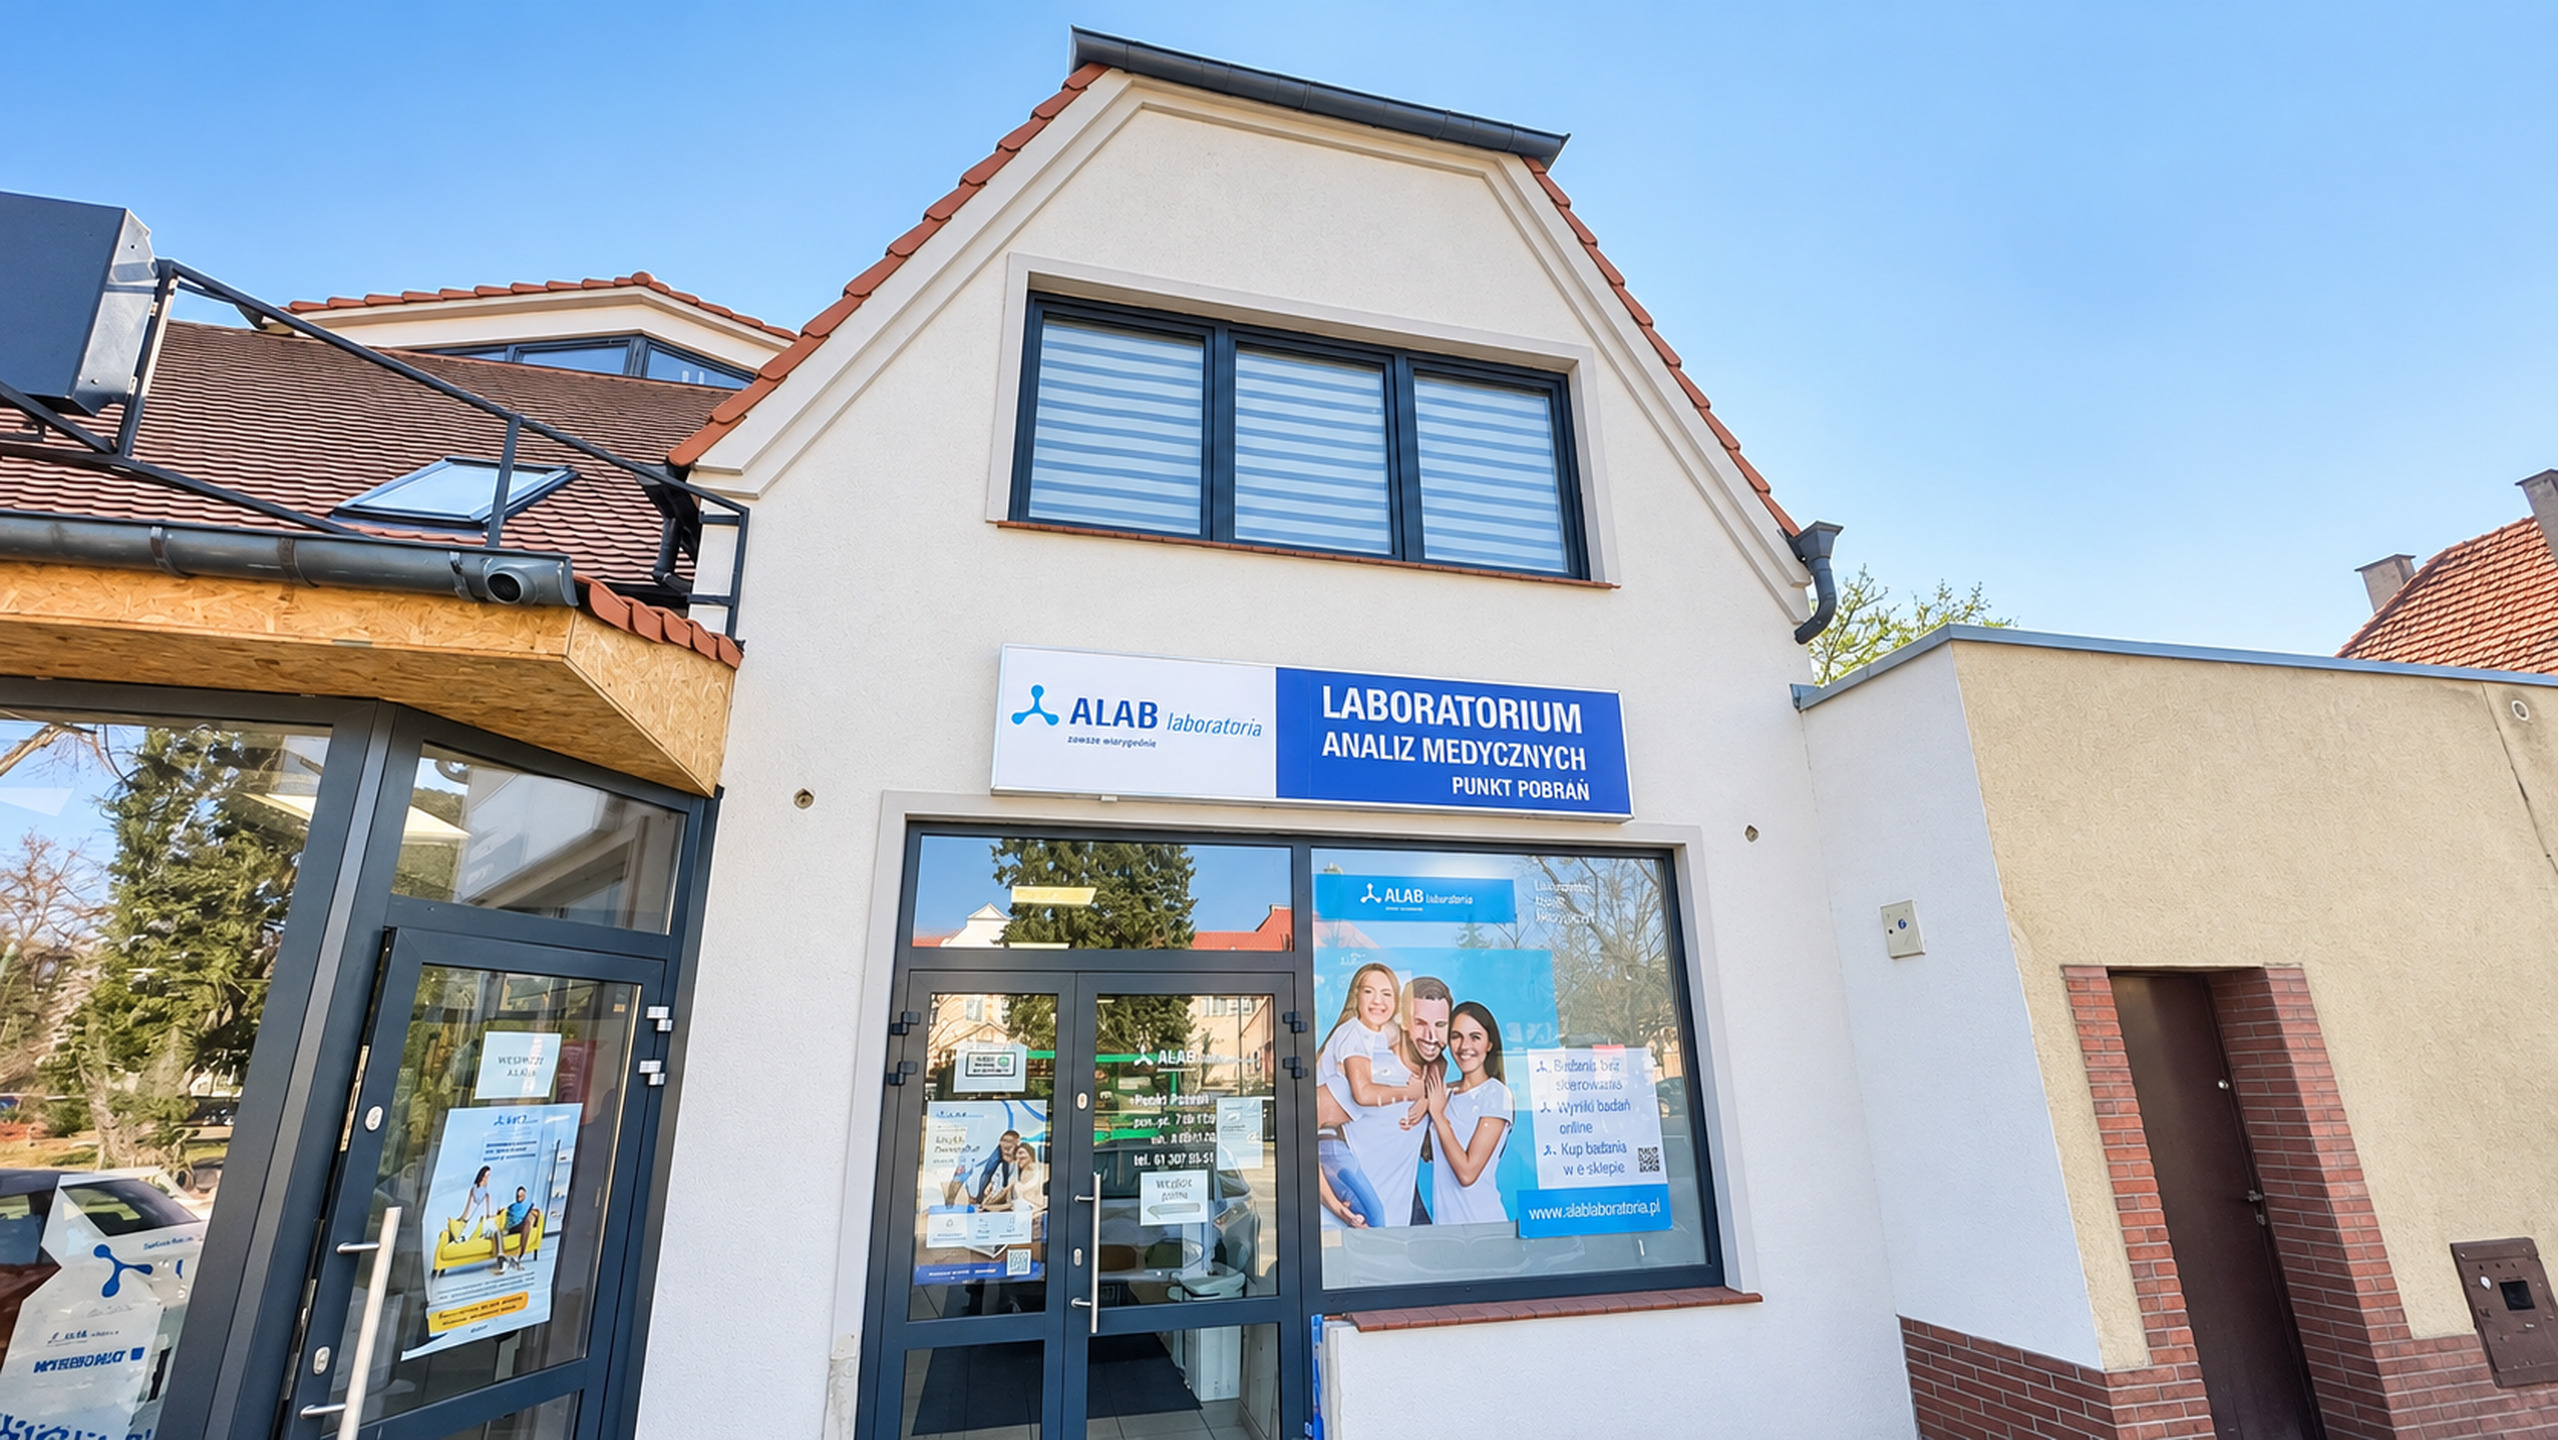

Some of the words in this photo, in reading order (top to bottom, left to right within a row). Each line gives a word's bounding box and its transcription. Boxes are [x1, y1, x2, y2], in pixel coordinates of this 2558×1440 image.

[1069, 697, 1158, 729] ALAB
[1166, 712, 1263, 737] laboratoria
[1322, 685, 1583, 734] LABORATORIUM
[1321, 731, 1416, 762] ANALIZ
[1422, 737, 1587, 771] MEDYCZNYCH
[1452, 776, 1513, 798] PUNKT
[1518, 777, 1591, 801] POBRAŃ
[1384, 887, 1424, 904] ALAB
[1559, 1122, 1593, 1135] online
[1561, 1142, 1583, 1158] Kup
[1563, 1165, 1574, 1176] w
[1528, 1197, 1661, 1221] www.alablaboratoria.pl
